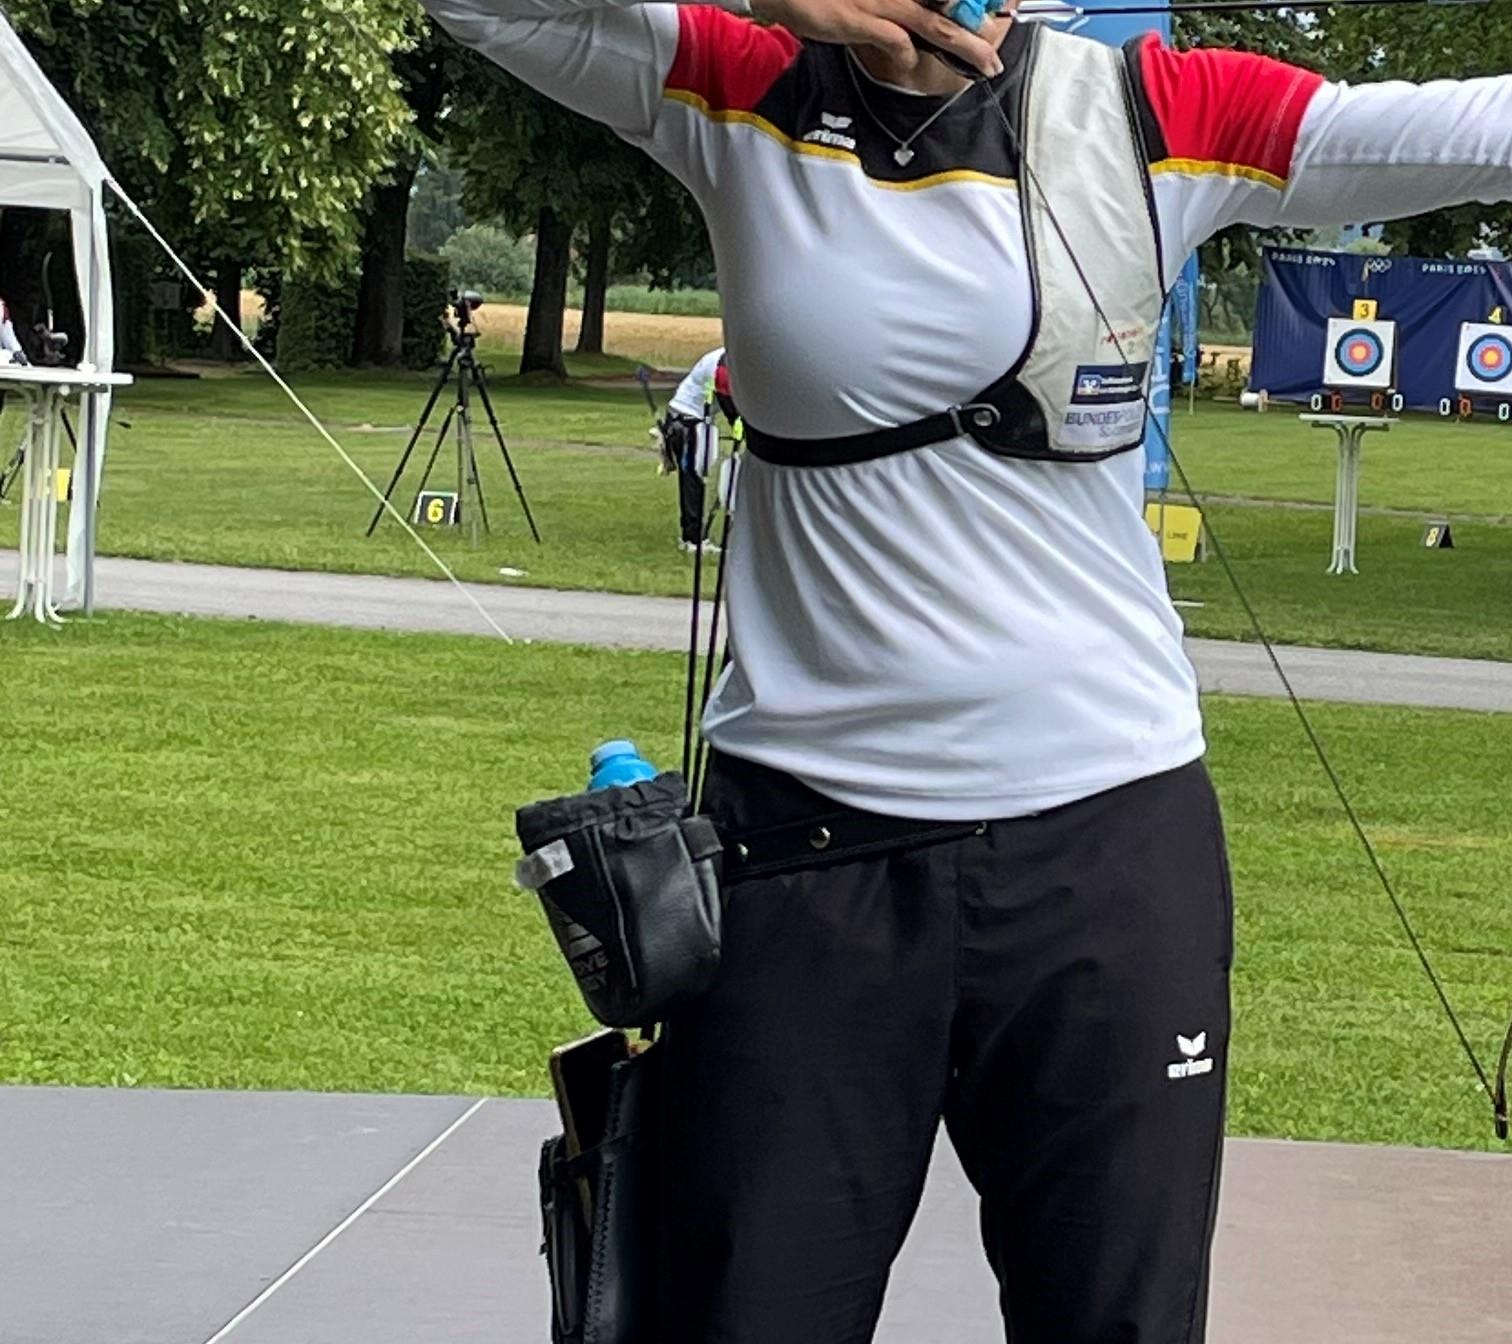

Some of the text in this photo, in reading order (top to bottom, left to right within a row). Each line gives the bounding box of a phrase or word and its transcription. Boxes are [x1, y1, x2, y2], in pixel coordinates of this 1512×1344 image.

[1360, 303, 1369, 318] 3
[1488, 307, 1502, 324] 4
[427, 498, 444, 523] 6
